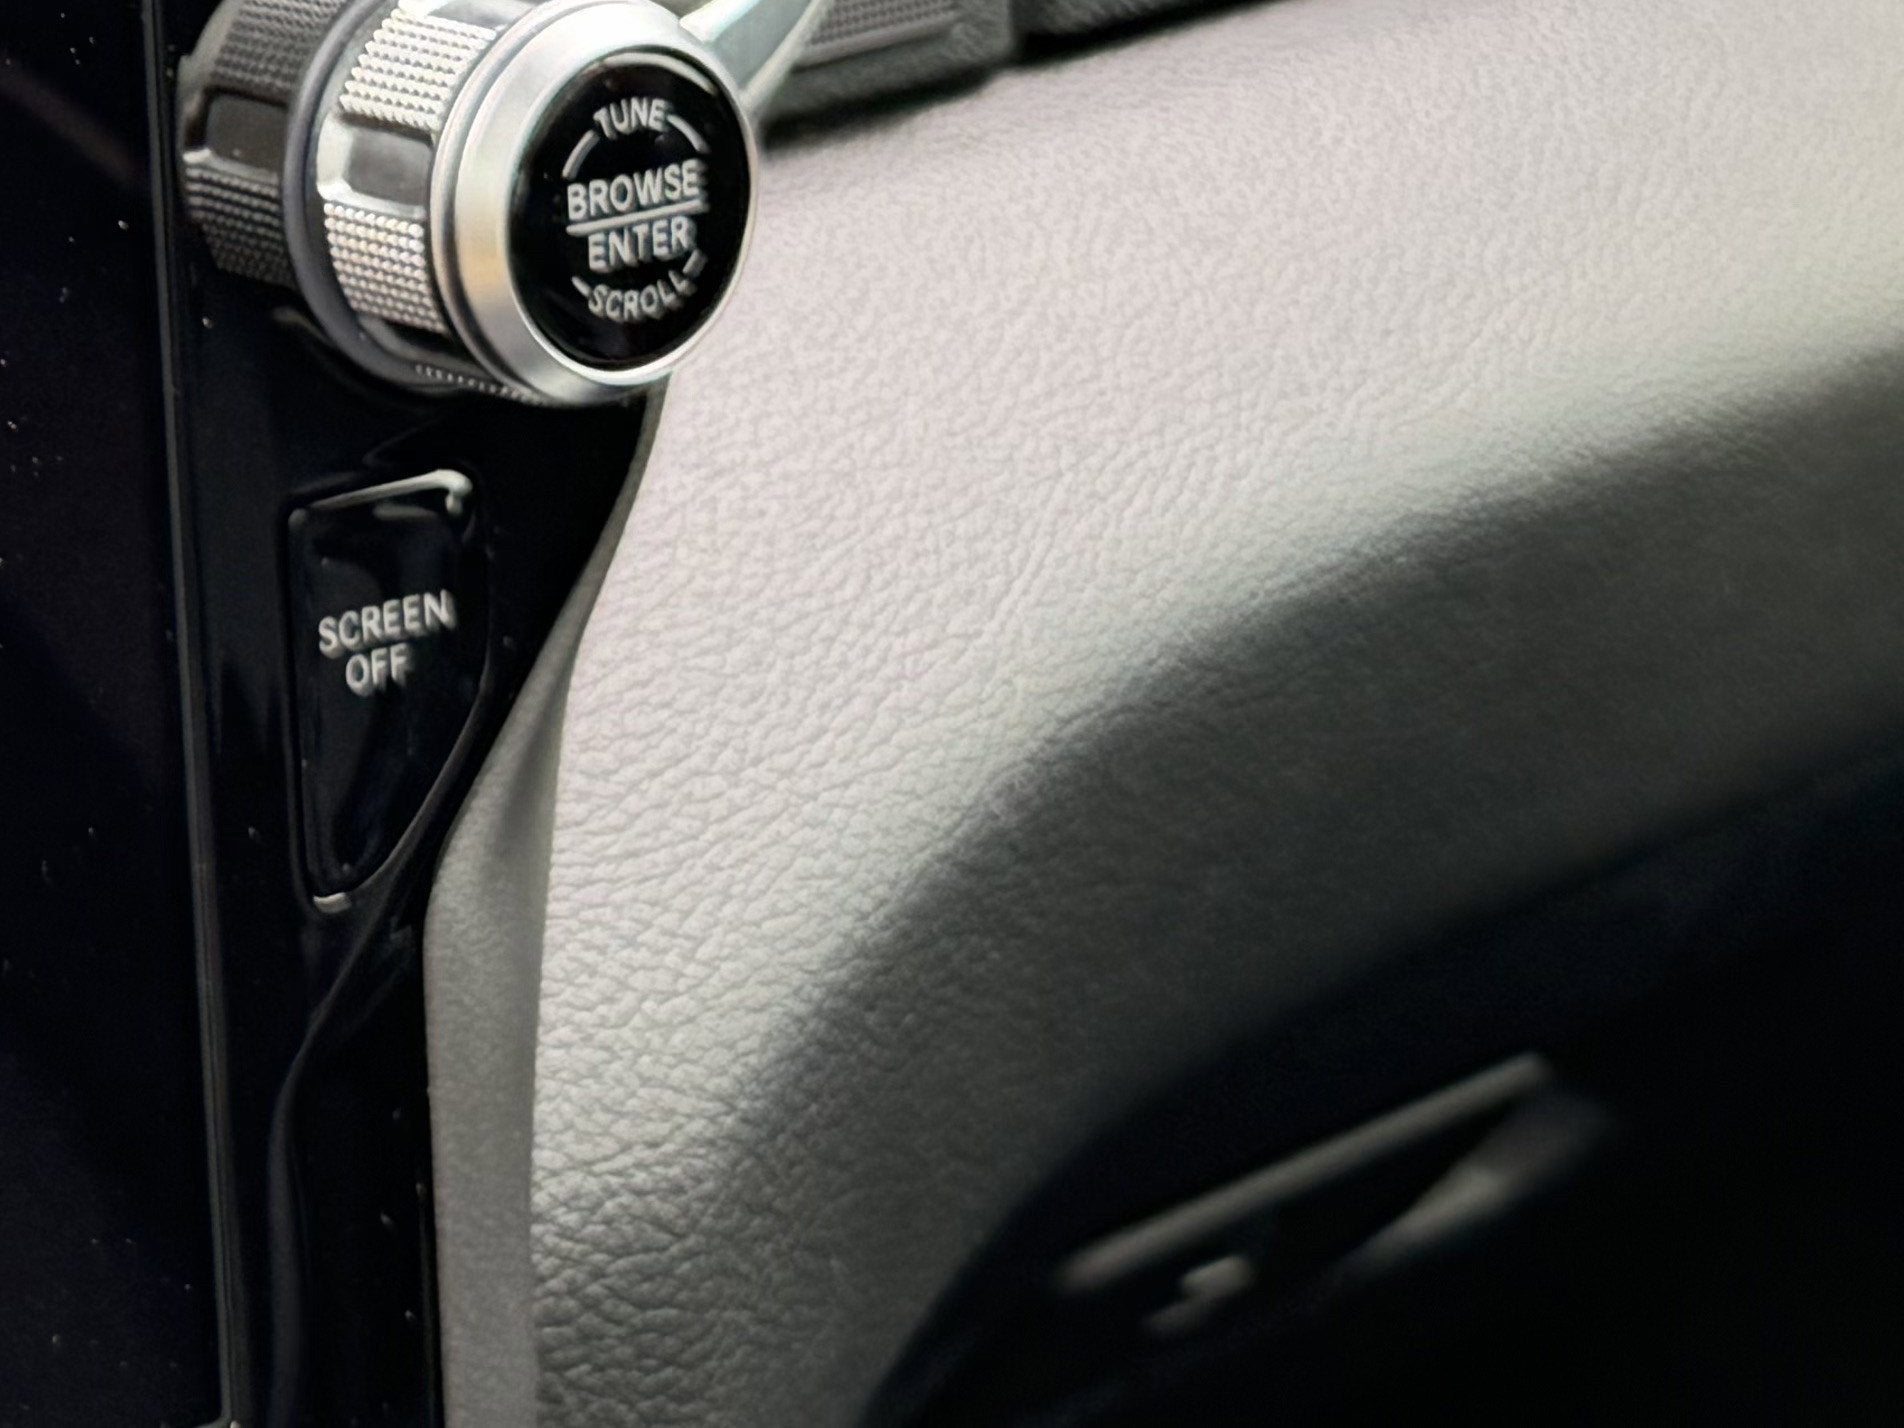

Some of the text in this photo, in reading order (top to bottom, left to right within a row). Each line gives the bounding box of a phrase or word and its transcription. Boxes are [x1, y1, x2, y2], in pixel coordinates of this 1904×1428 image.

[593, 96, 673, 140] TUNE
[566, 158, 708, 222] BROWSE
[587, 215, 695, 273] ENTER
[587, 270, 694, 323] SCROLL
[318, 588, 458, 660] SCREEN
[345, 642, 414, 697] OFF
